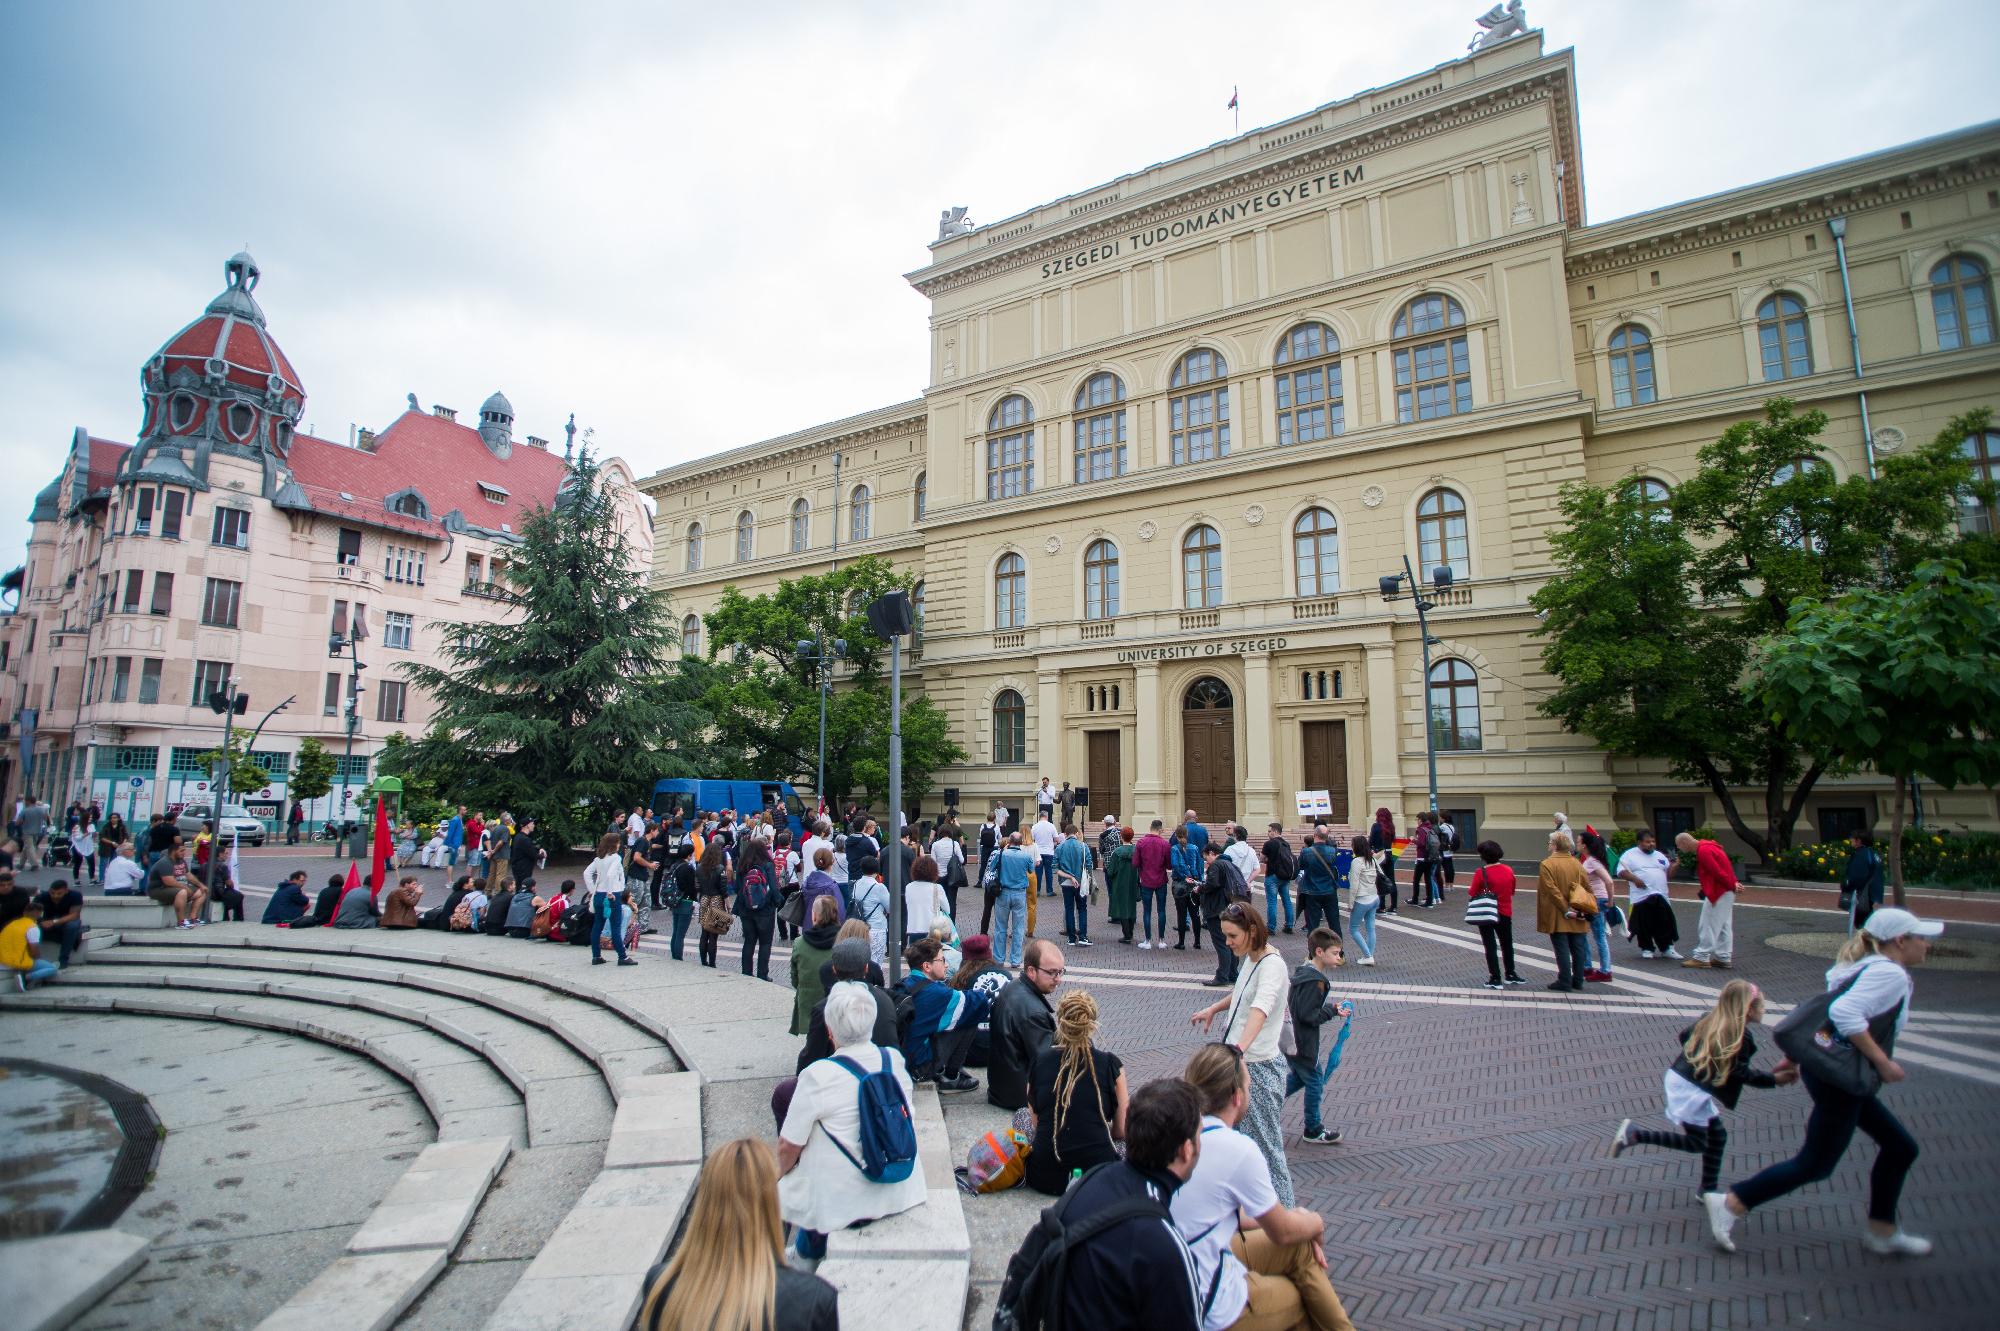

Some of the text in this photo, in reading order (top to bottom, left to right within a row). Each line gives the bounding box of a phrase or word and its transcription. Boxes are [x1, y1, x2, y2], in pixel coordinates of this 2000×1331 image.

[1042, 164, 1365, 279] SZEGEDI TUDOMÁNYEGYETEM
[1117, 637, 1288, 663] UNIVERSITY OF SZEGED
